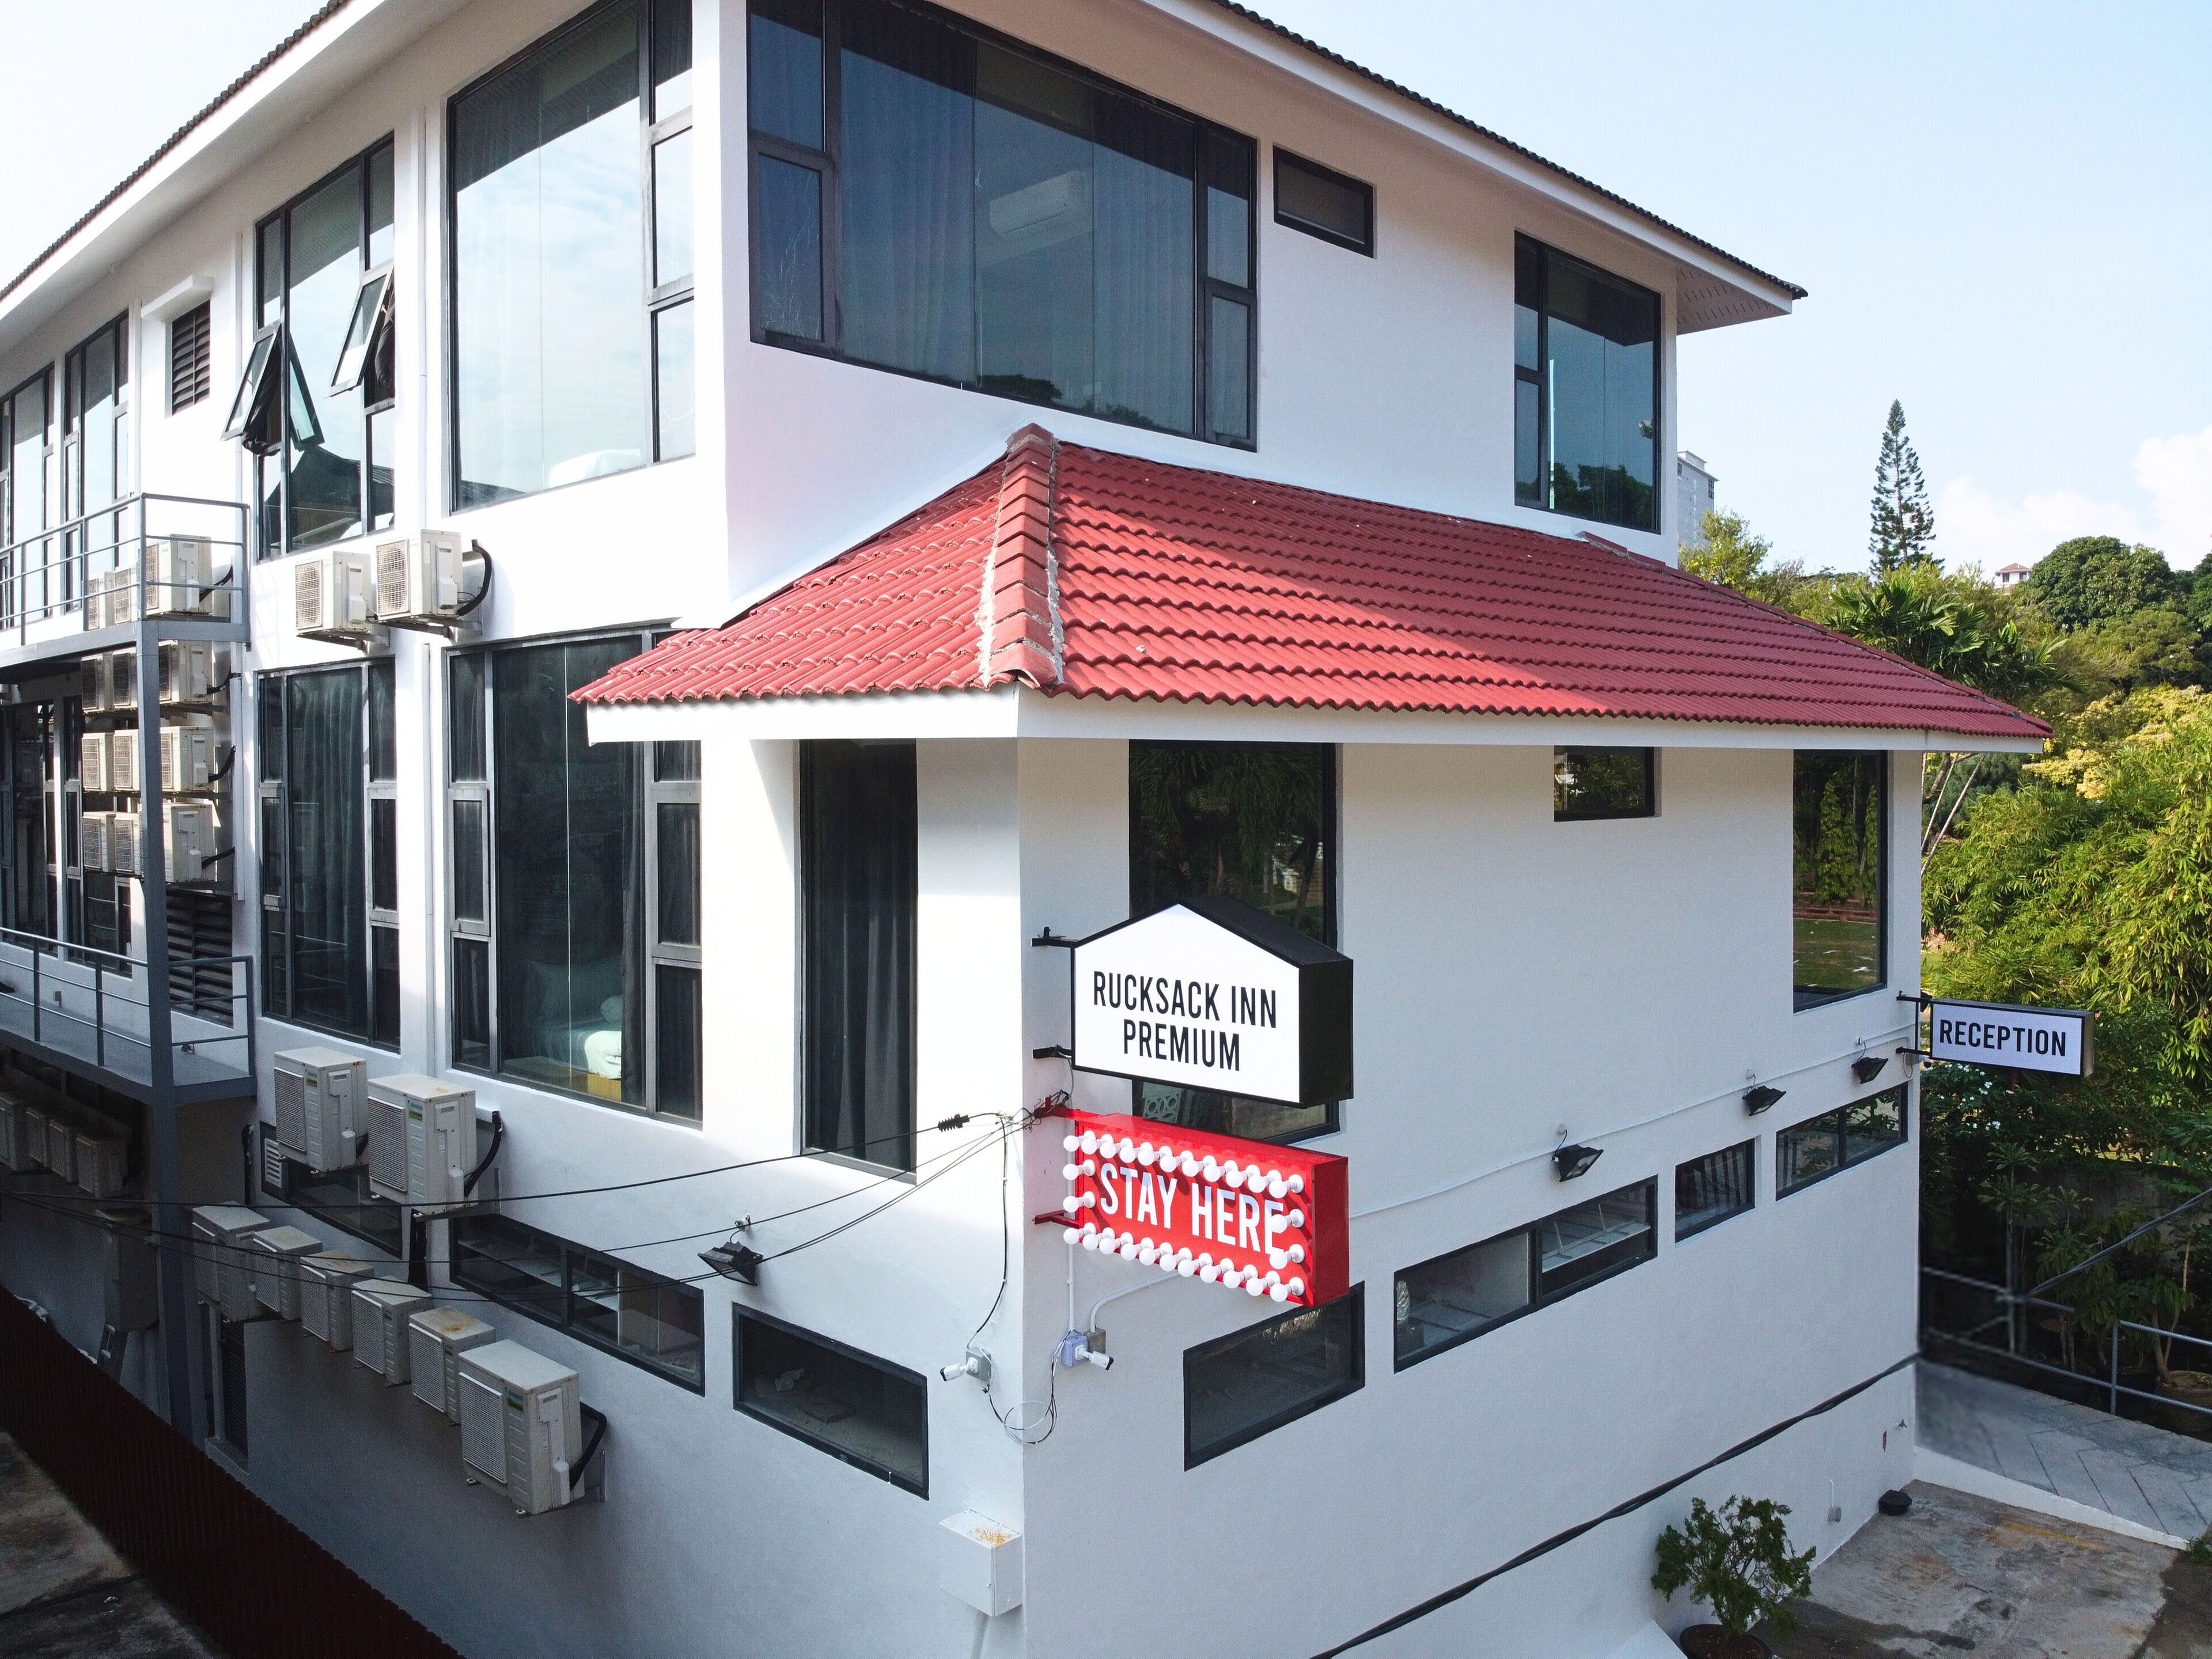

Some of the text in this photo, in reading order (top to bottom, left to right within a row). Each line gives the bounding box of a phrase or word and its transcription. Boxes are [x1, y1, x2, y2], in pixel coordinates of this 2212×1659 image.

[1094, 971, 1276, 1028] RUCKSACK INN
[1124, 1018, 1239, 1071] PREMIUM
[1940, 1019, 2066, 1056] RECEPTION
[1100, 1162, 1285, 1256] STAY HERE
